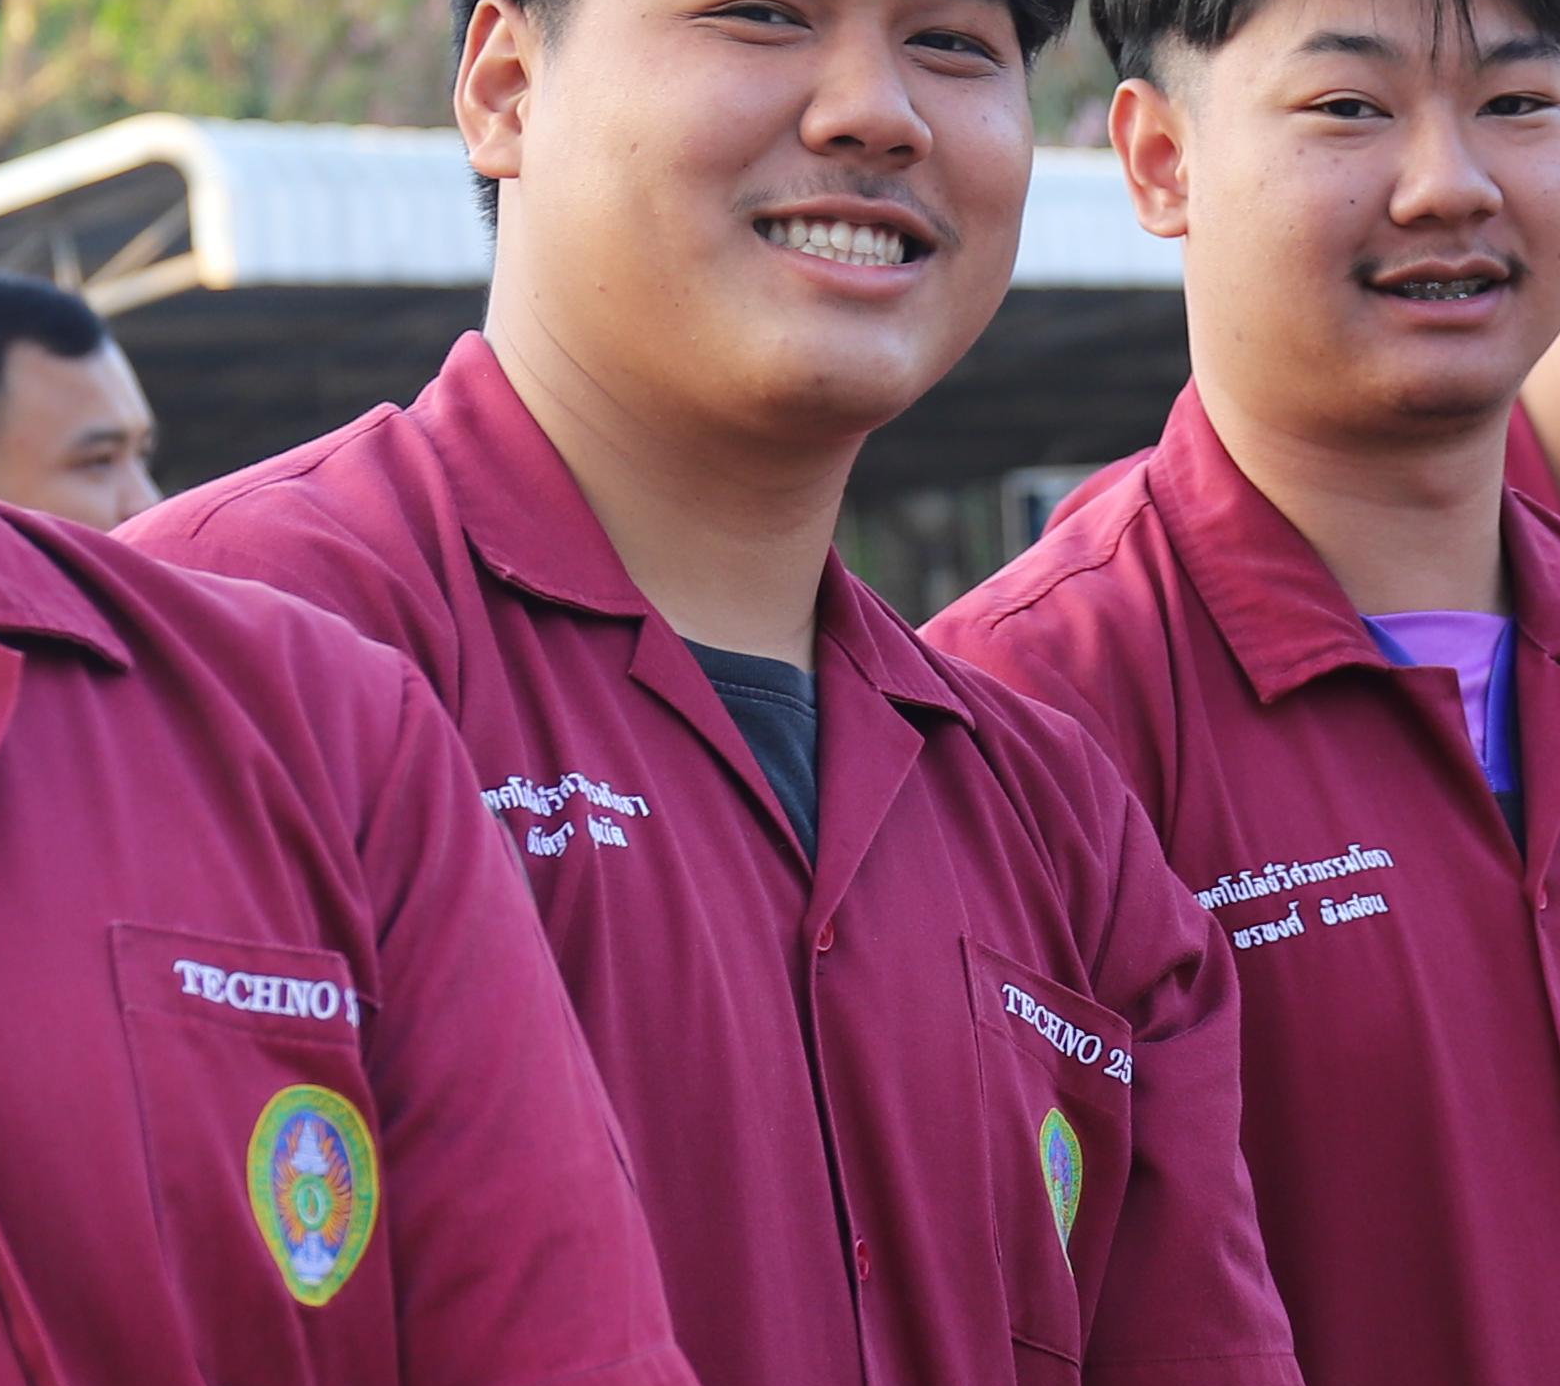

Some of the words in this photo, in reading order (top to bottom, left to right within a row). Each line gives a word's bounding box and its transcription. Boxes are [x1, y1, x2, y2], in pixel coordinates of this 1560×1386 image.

[1191, 843, 1395, 912] ทคโนโลยีวิศวกรรมโยธา
[173, 959, 340, 1020] TECHNO
[1001, 983, 1102, 1064] TECHNO
